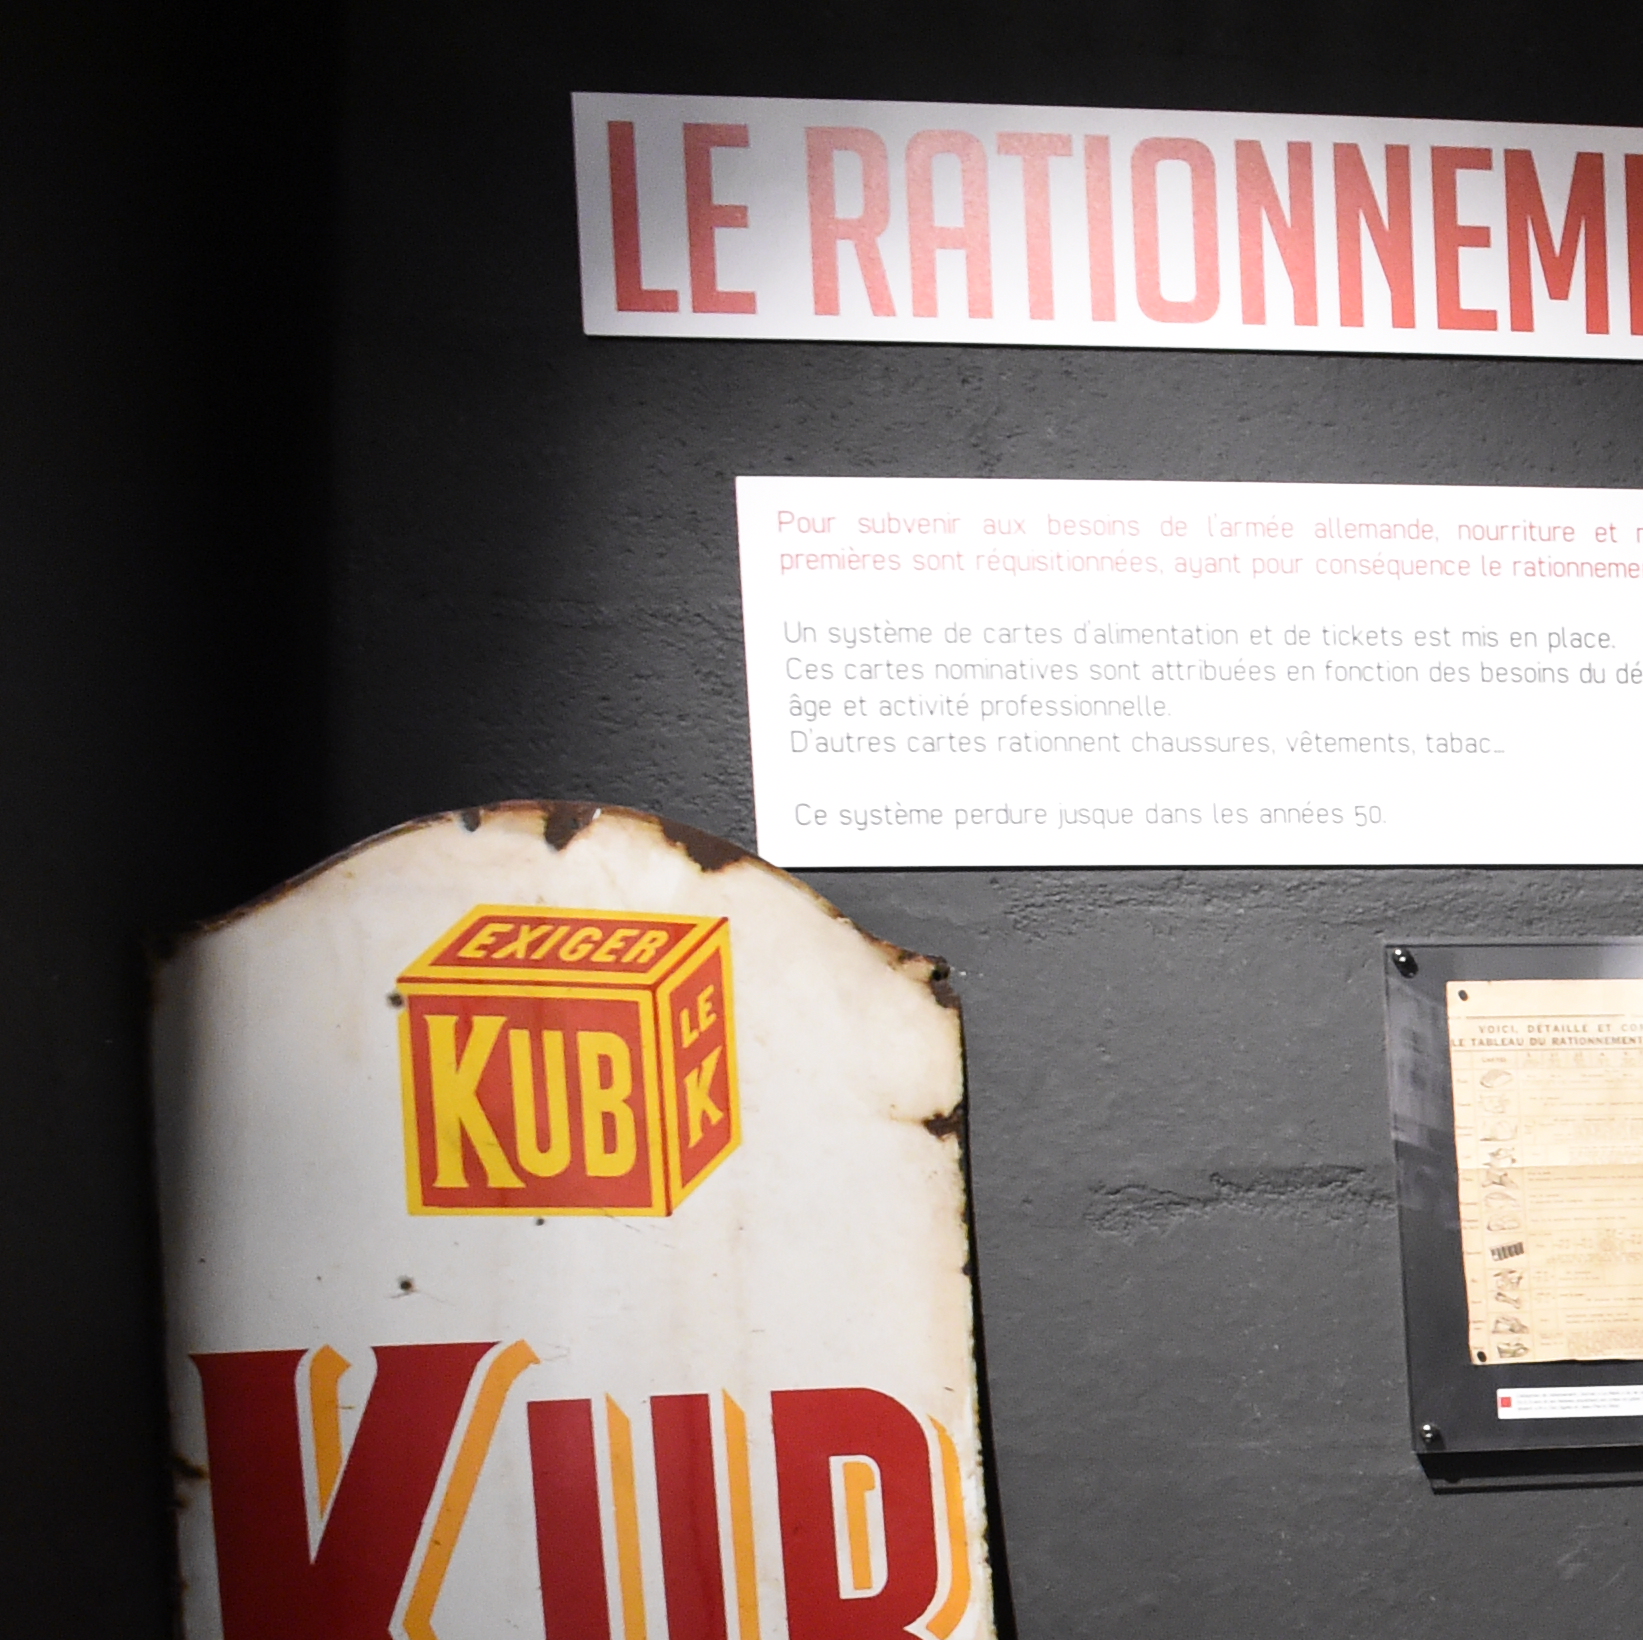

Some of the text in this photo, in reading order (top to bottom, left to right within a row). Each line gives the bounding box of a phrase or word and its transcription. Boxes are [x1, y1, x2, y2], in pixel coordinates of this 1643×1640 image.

[607, 119, 758, 317] LE
[778, 510, 835, 533] Pour
[858, 513, 960, 534] subvenir
[984, 519, 1025, 534] aux
[1048, 514, 1140, 536] besoins
[1161, 516, 1187, 537] de
[1208, 513, 1293, 538] l'armée
[1315, 518, 1438, 541] allemande,
[1459, 522, 1575, 542] nourriture
[1595, 524, 1617, 543] et
[781, 547, 901, 574] premières
[913, 552, 964, 570] sont
[976, 548, 1163, 576] réquisitionnées,
[1175, 554, 1240, 578] ayant
[1253, 558, 1303, 578] pour
[1316, 553, 1470, 580] conséquence
[1482, 555, 1501, 576] le
[784, 620, 1615, 652] Un système de cartes d'alimentation et de tickets est mis en place.
[787, 658, 833, 679] Ces
[845, 660, 924, 680] cartes
[936, 660, 1078, 680] nominatives
[1090, 661, 1140, 680] sont
[1152, 658, 1275, 681] attribuées
[1288, 666, 1314, 681] en
[1325, 660, 1418, 682] fonction
[1430, 662, 1470, 682] des
[1481, 662, 1568, 683] besoins
[1580, 663, 1605, 683] du
[790, 693, 1171, 722] âge et activité professionnelle.
[791, 729, 1504, 753] D'autres cartes rationnent chaussures, vêtements, tabac...
[796, 802, 1386, 830] Ce système perdure jusque dans les années 50.
[458, 920, 669, 965] EXIGER
[678, 981, 716, 1048] LE
[431, 1012, 637, 1192] KUB
[685, 1060, 725, 1150] K
